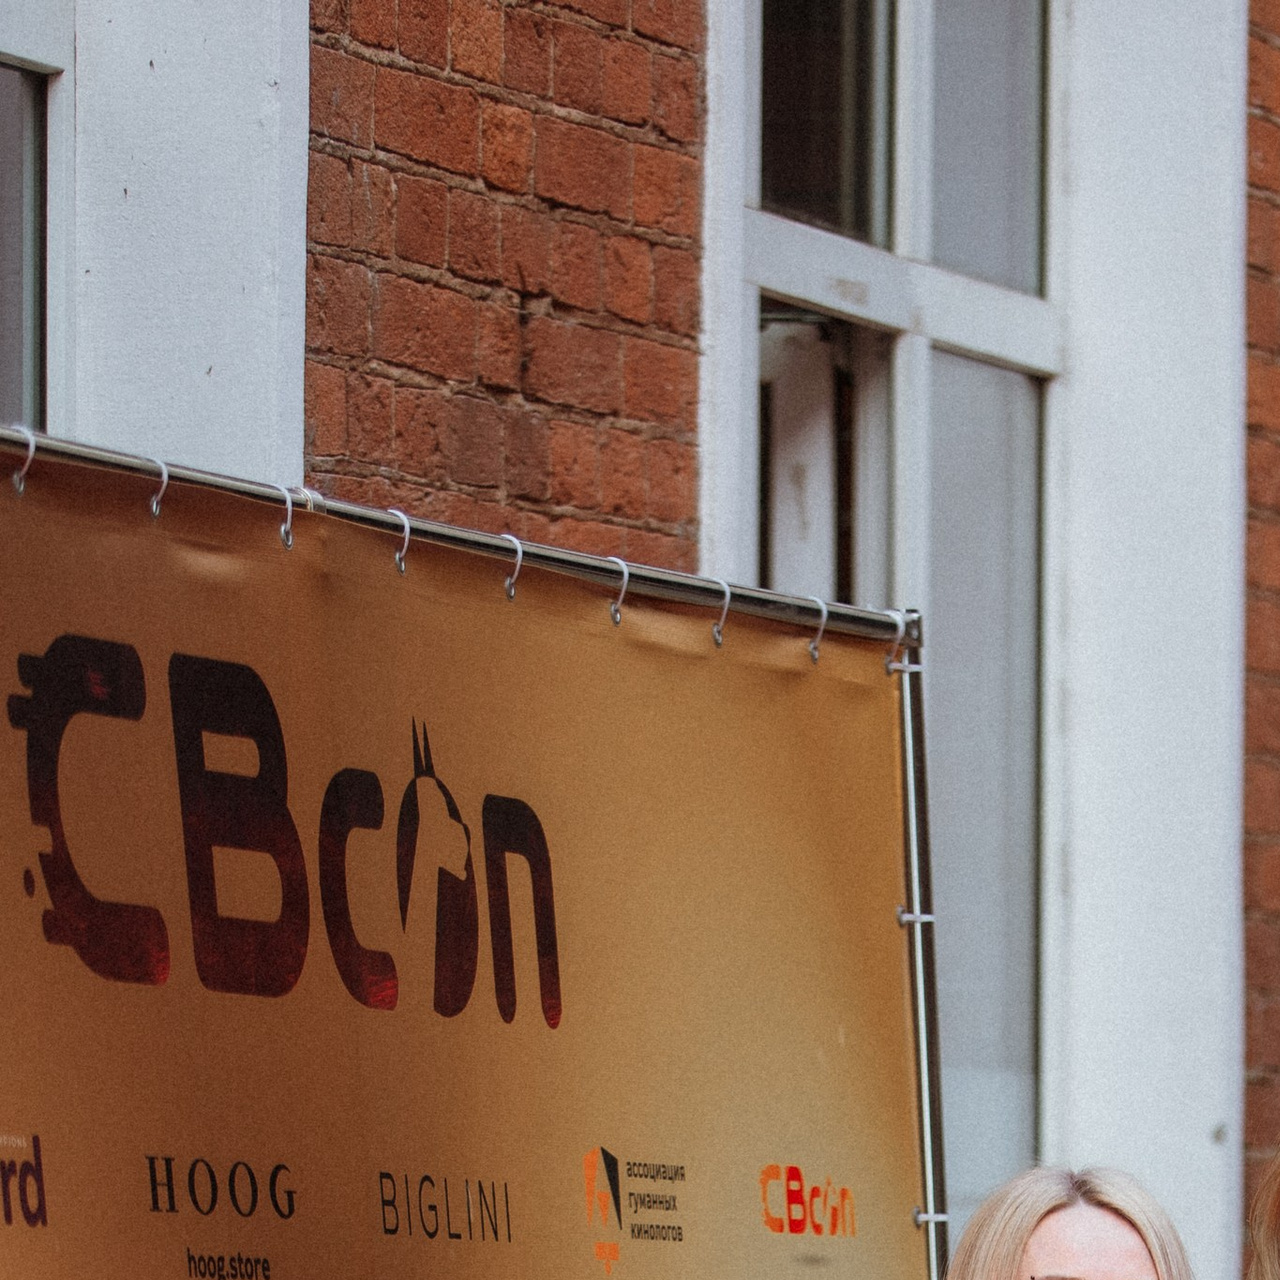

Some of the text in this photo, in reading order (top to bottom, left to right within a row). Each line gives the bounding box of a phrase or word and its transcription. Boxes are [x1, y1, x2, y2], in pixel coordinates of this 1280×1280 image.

[8, 633, 562, 1030] CBcon
[146, 1156, 297, 1220] HOOG
[626, 1161, 686, 1182] ассоциация
[628, 1192, 678, 1214] гуманных
[760, 1164, 857, 1238] CBcon
[380, 1171, 511, 1243] BIGLINI
[631, 1223, 684, 1242] кинологов
